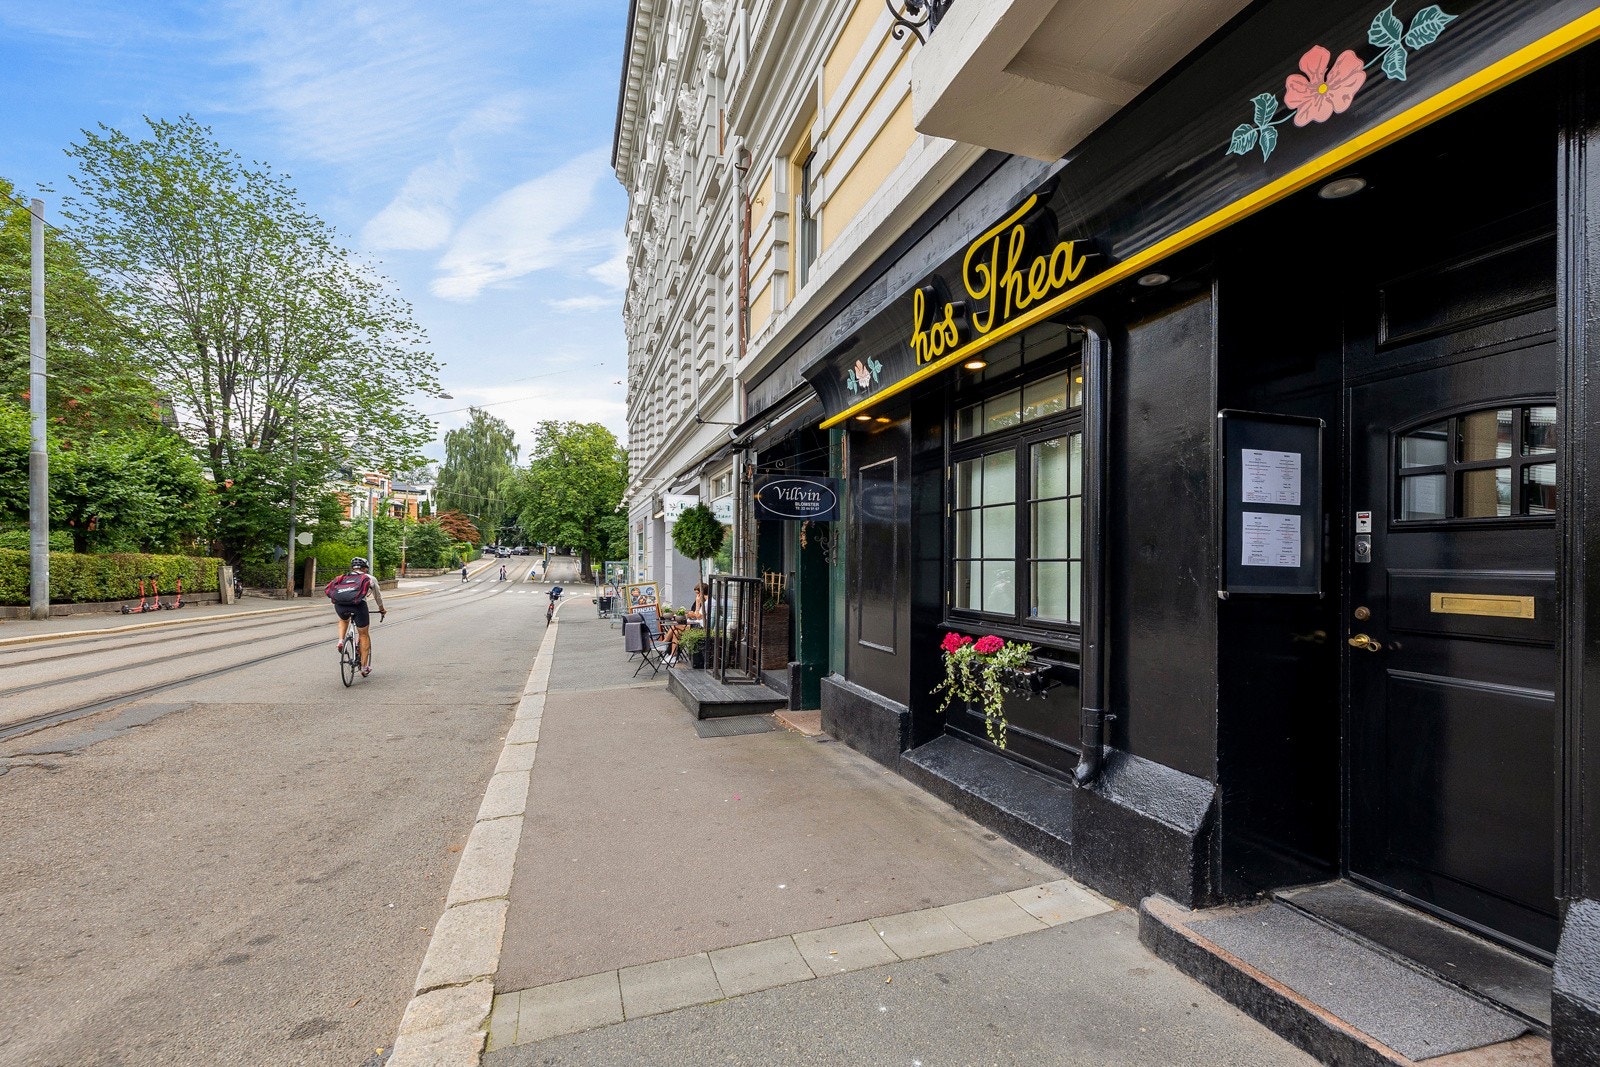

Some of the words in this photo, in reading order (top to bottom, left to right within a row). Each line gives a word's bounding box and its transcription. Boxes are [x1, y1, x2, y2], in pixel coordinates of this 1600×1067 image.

[910, 288, 959, 366] hos
[963, 194, 1086, 333] Thea
[773, 486, 821, 501] Villvin
